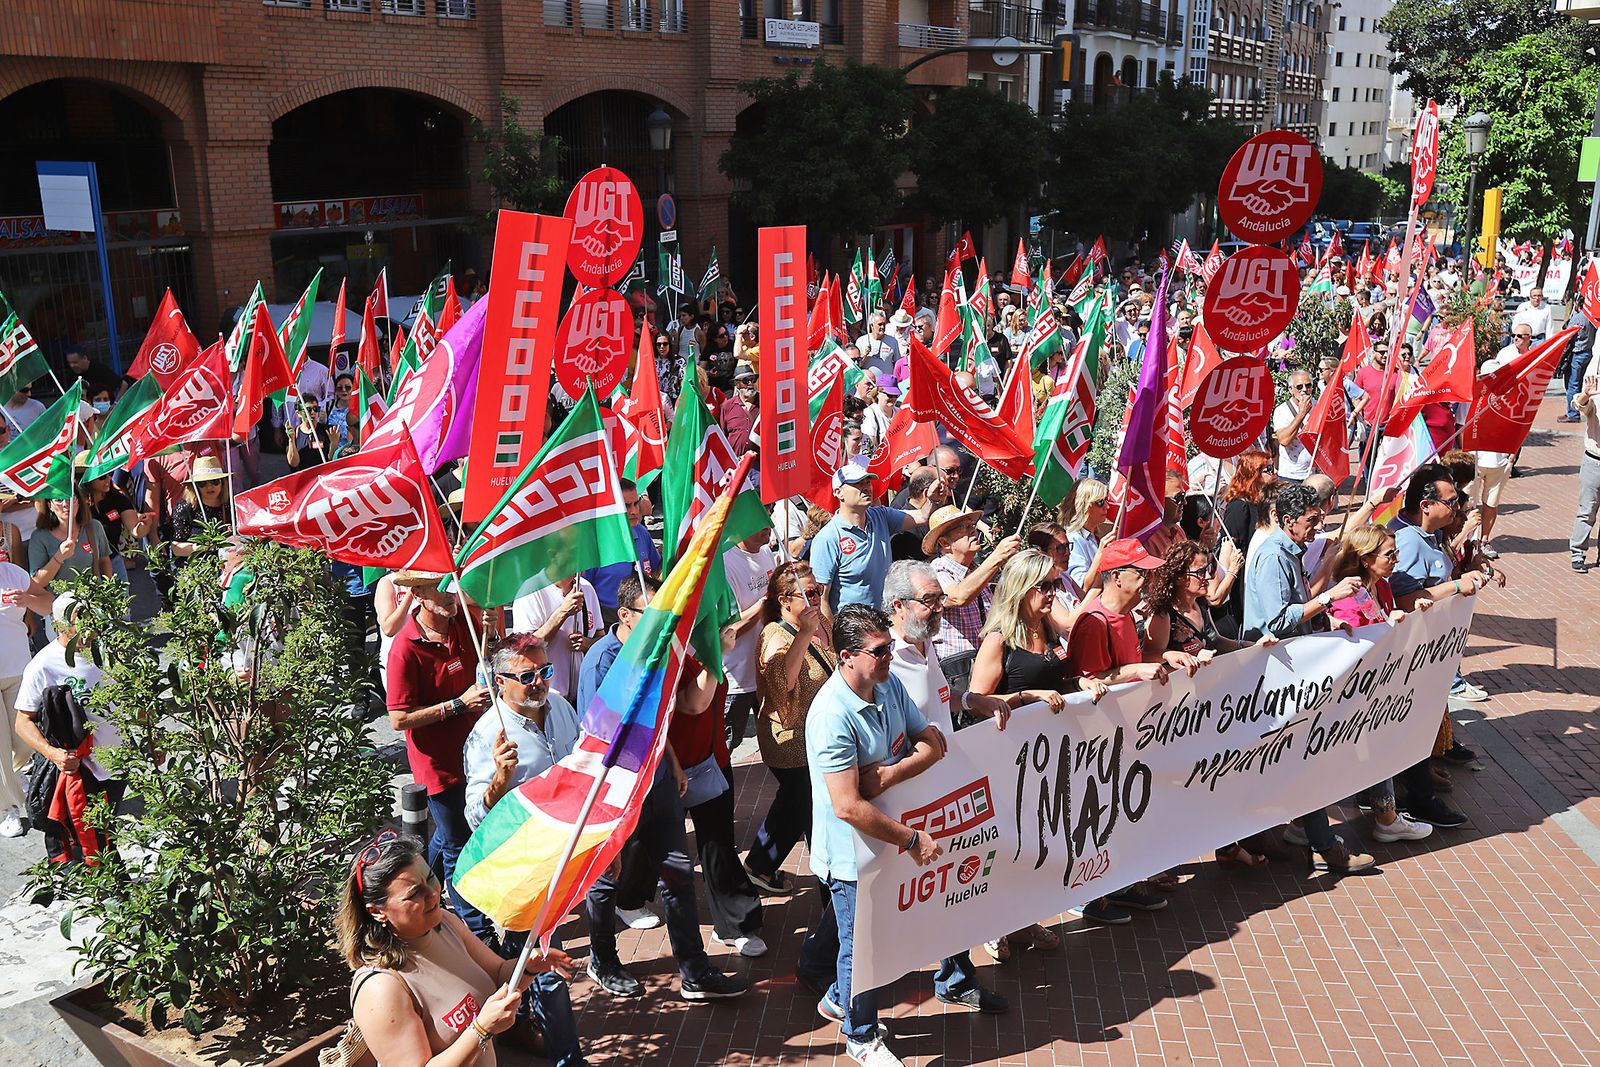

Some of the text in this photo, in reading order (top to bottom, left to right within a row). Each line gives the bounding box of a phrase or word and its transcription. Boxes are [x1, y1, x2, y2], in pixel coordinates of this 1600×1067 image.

[1236, 143, 1312, 186] UGT
[574, 181, 632, 227] UGT
[579, 257, 623, 276] Andalucía
[1219, 258, 1289, 298] UGT
[498, 241, 549, 422] CCOO
[567, 299, 626, 347] UGT
[772, 252, 797, 416] CCOO
[1205, 366, 1265, 408] UGT
[777, 461, 797, 473] HUELVA
[1136, 691, 1212, 750] Subir
[1336, 652, 1403, 705] bajar
[1184, 688, 1415, 792] repartir beneficios
[1033, 726, 1153, 890] MAYO
[948, 823, 999, 853] Huelva
[897, 861, 955, 912] UGT
[1070, 849, 1111, 889] 2023
[944, 881, 989, 908] Huelva
